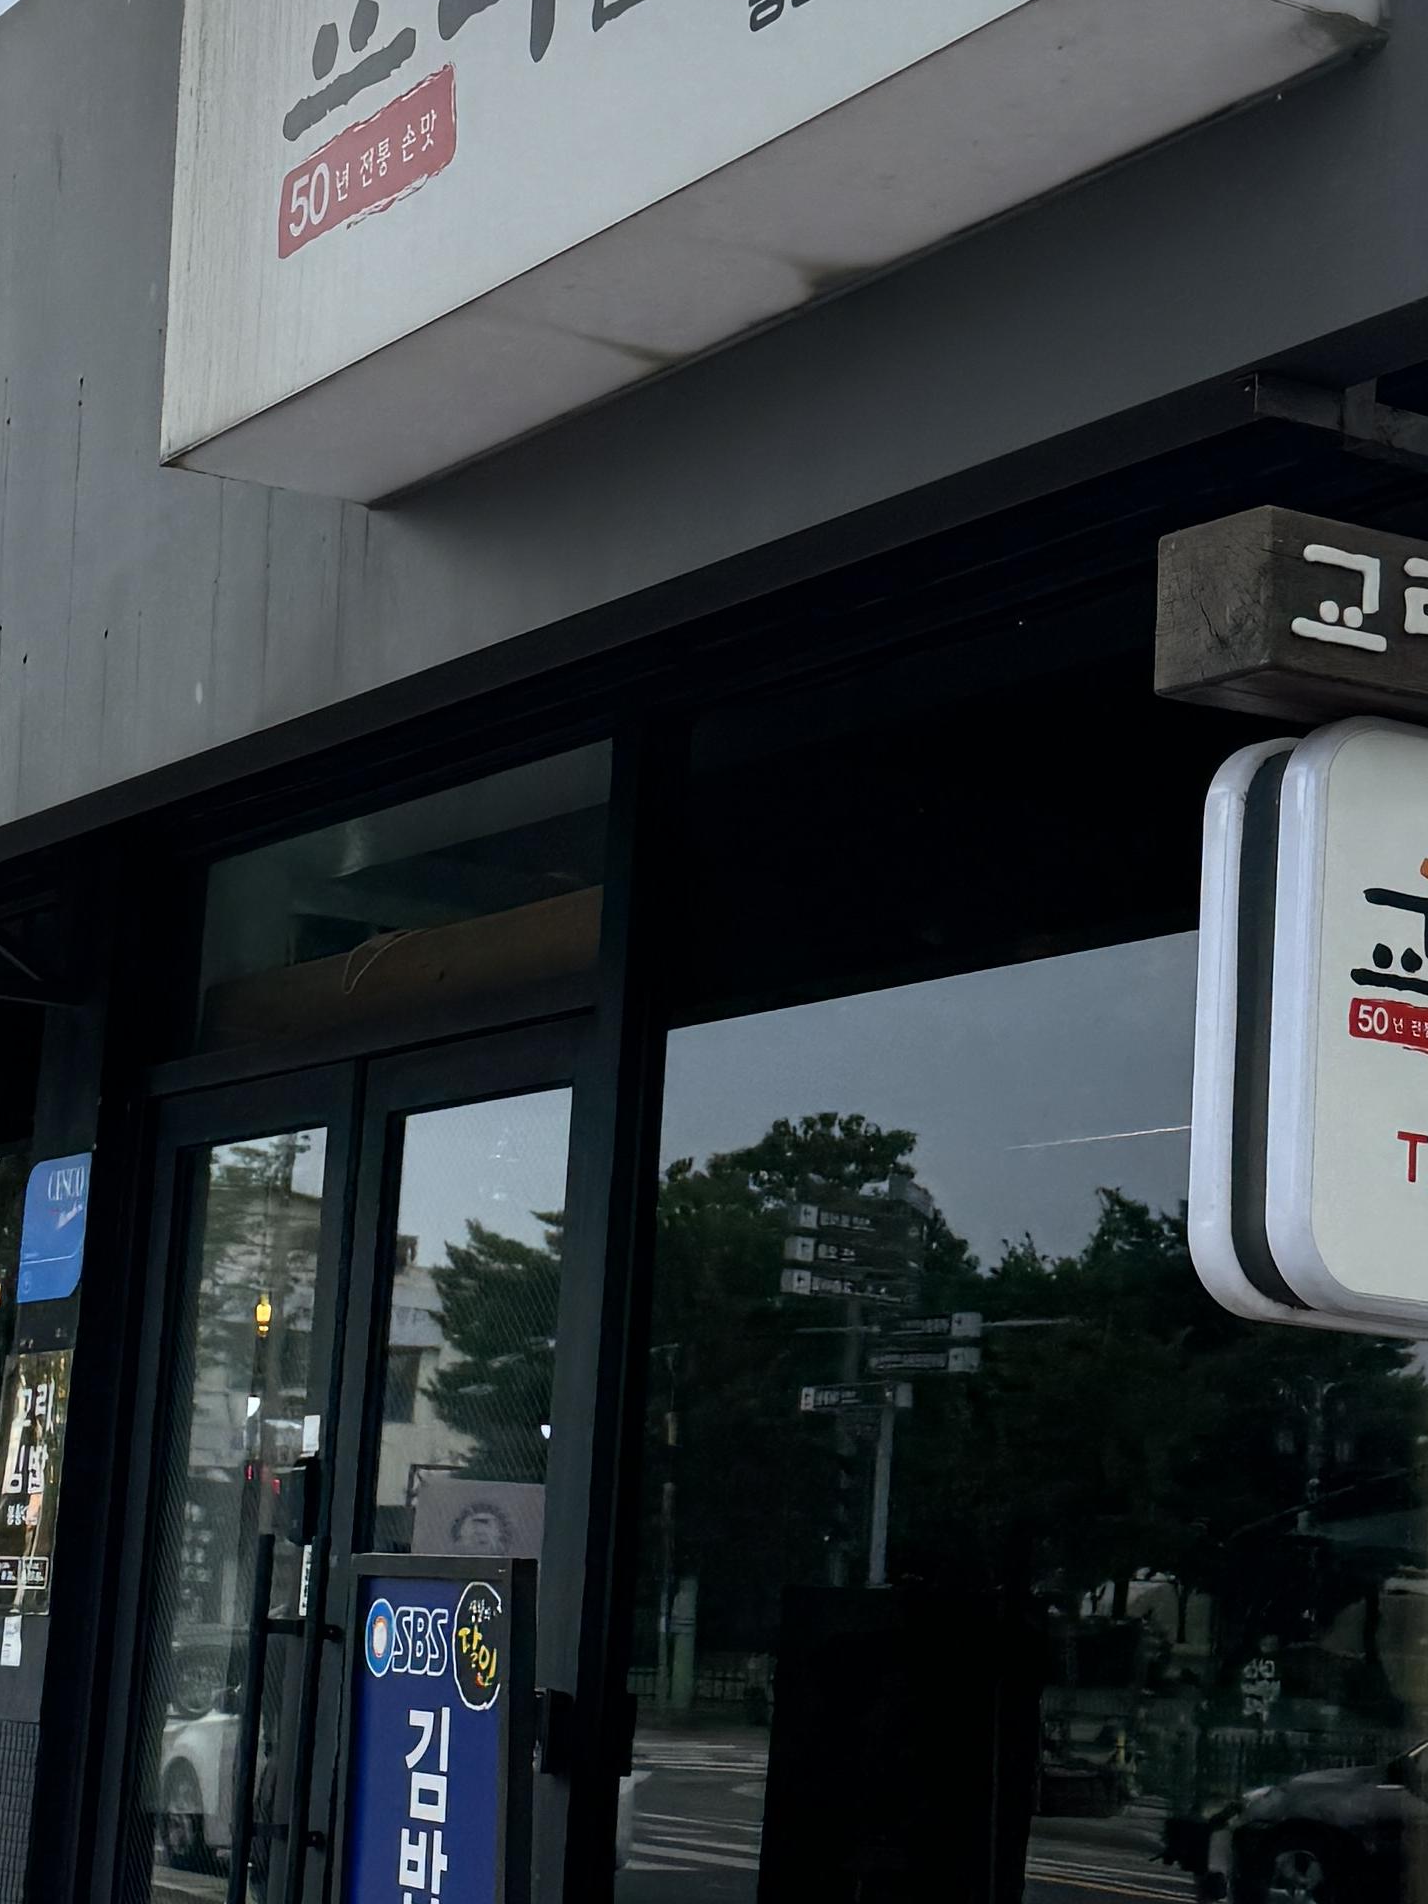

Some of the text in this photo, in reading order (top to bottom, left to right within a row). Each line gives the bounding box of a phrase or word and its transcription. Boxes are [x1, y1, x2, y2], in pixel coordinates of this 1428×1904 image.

[359, 137, 391, 188] 전통
[401, 108, 438, 162] 손맛
[392, 1606, 448, 1676] SBS
